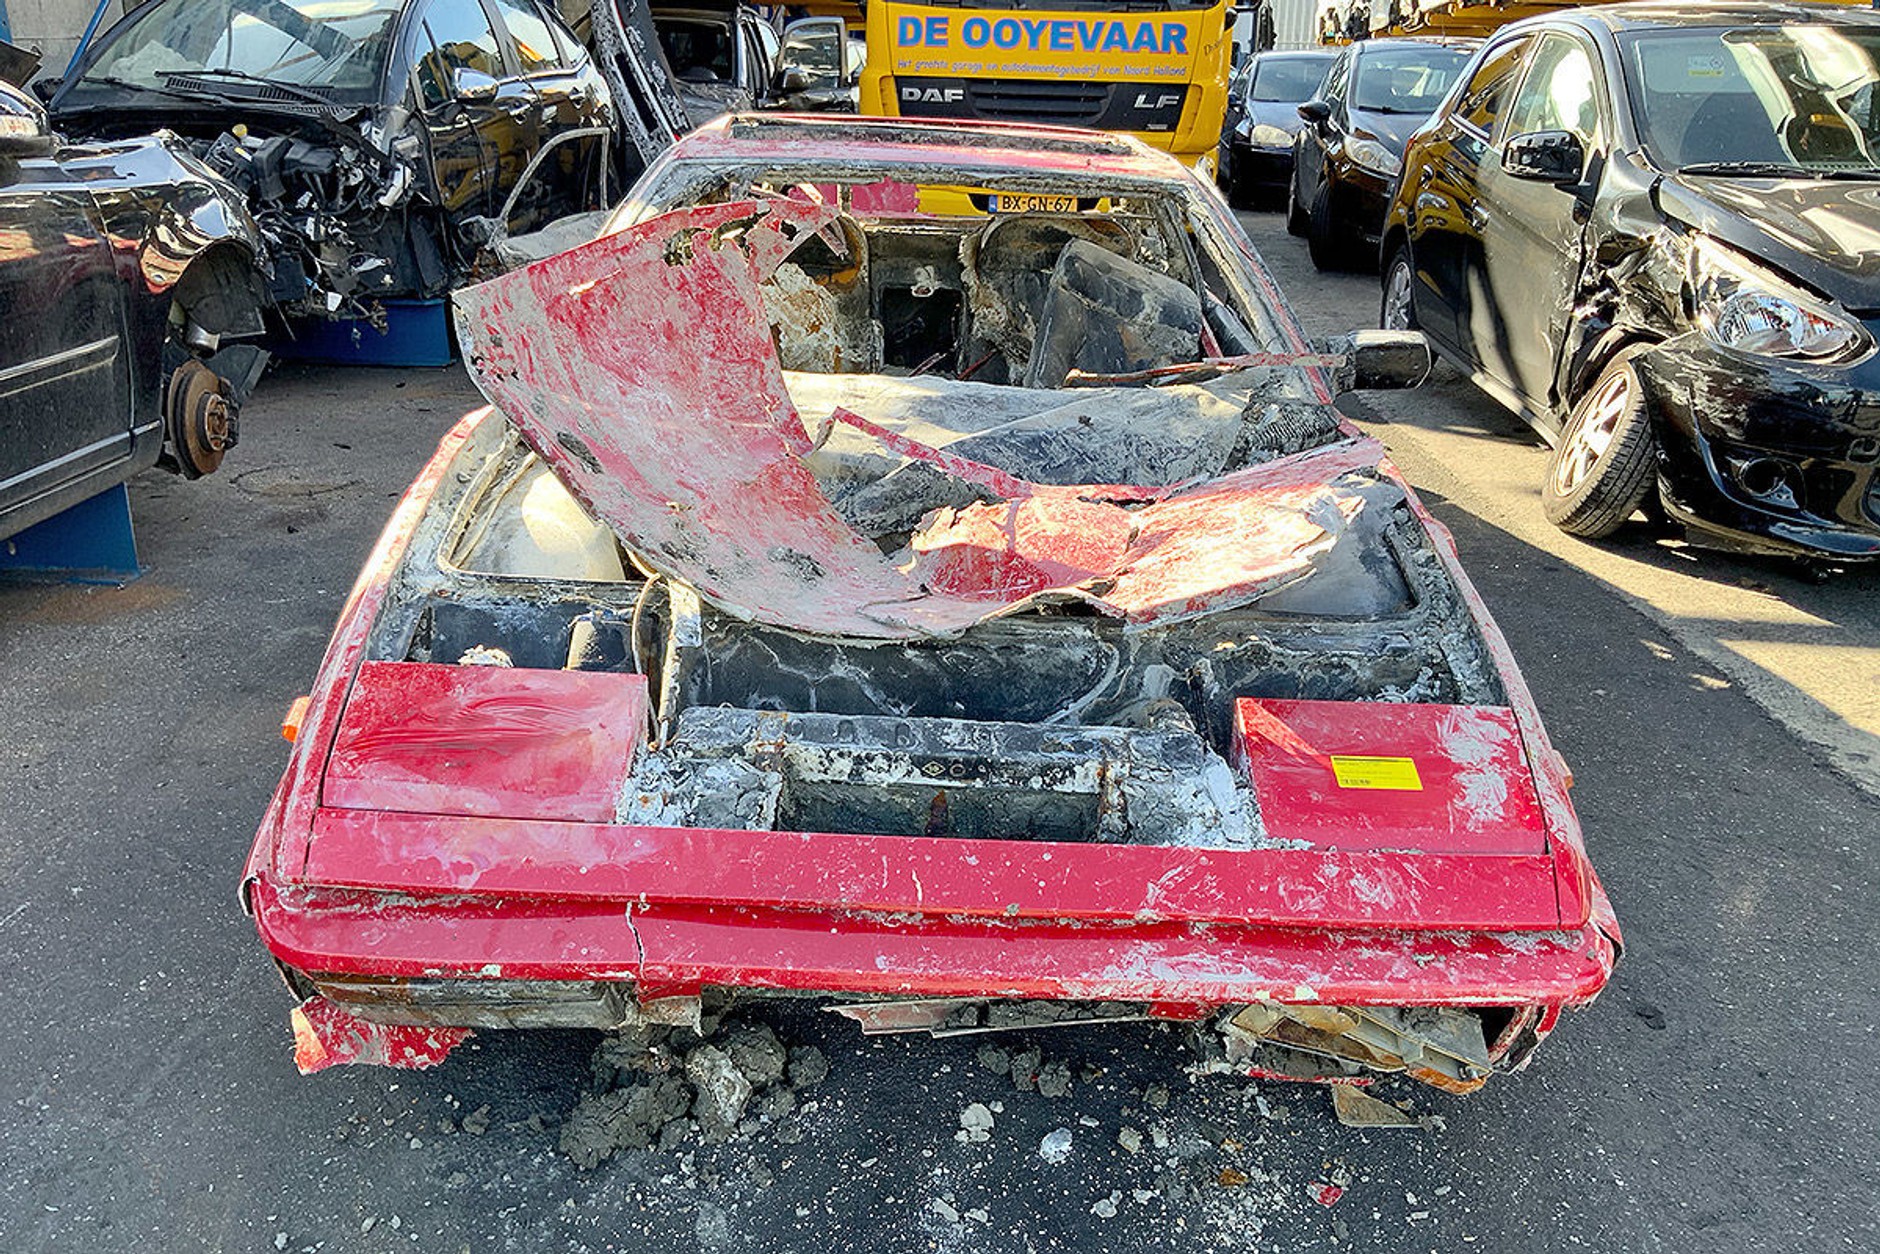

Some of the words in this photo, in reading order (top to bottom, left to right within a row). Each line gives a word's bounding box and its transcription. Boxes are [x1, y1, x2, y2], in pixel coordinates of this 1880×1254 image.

[897, 16, 949, 48] DE
[962, 18, 1188, 54] OOYEVAAR
[897, 59, 912, 68] Het
[952, 61, 983, 74] garage
[986, 63, 998, 71] en
[1103, 66, 1120, 75] van
[1124, 65, 1150, 75] Noord
[1153, 66, 1187, 76] Holland
[902, 87, 964, 102] DAF
[1134, 94, 1179, 109] LF
[1002, 195, 1073, 212] BX-GN-67
